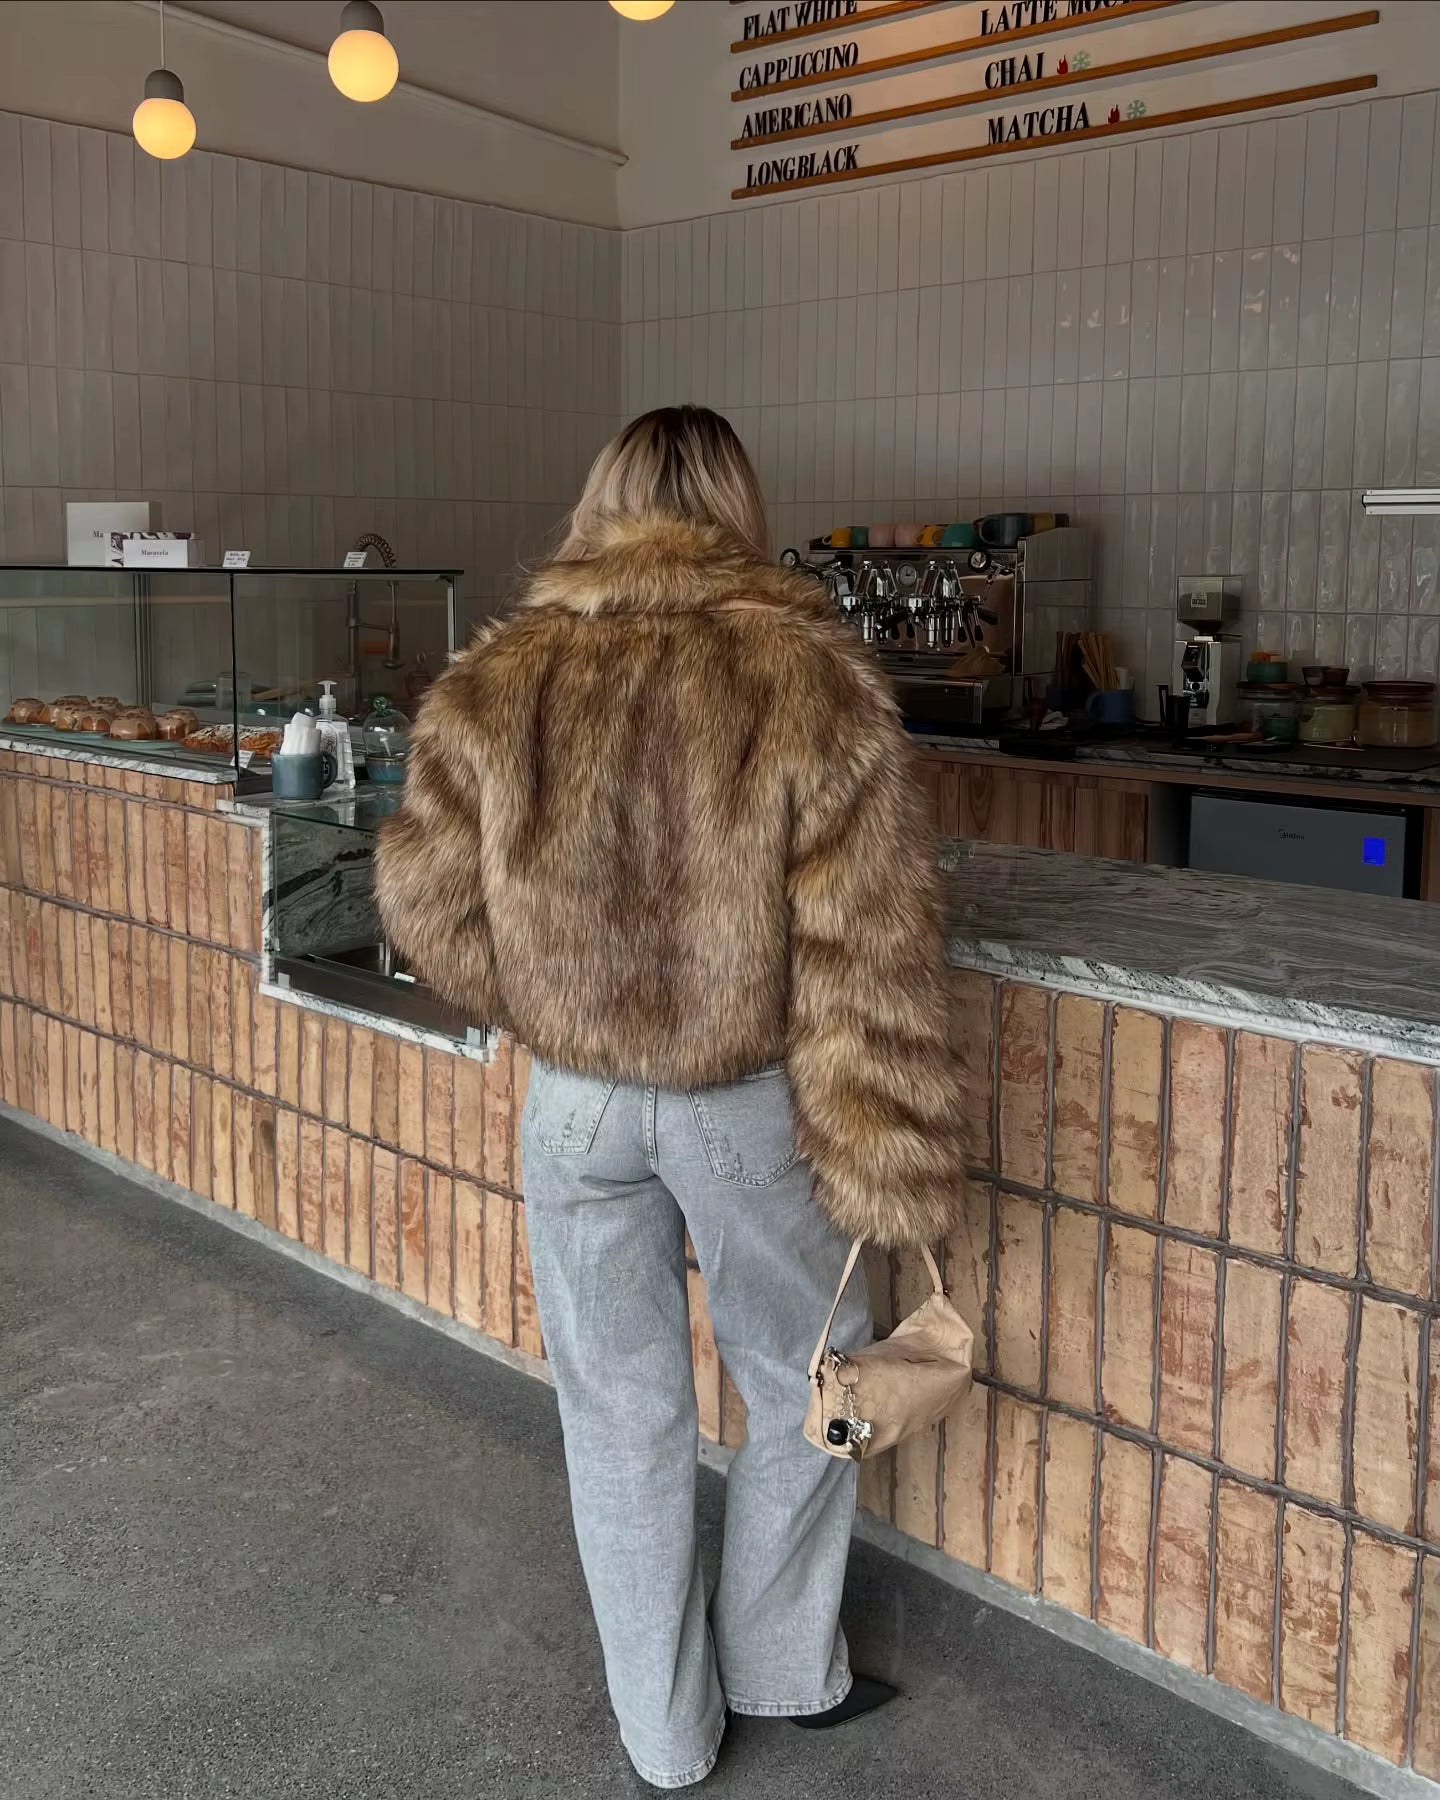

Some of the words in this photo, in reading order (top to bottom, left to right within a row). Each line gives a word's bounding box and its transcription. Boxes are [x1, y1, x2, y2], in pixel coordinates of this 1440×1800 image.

[744, 7, 789, 40] FLAT
[795, 1, 857, 27] WHITE
[981, 1, 1057, 35] LATTE
[740, 42, 858, 90] CAPPUCCINO
[985, 52, 1045, 89] CHAI
[741, 94, 852, 140] AMERICANO
[988, 102, 1089, 145] MATCHA
